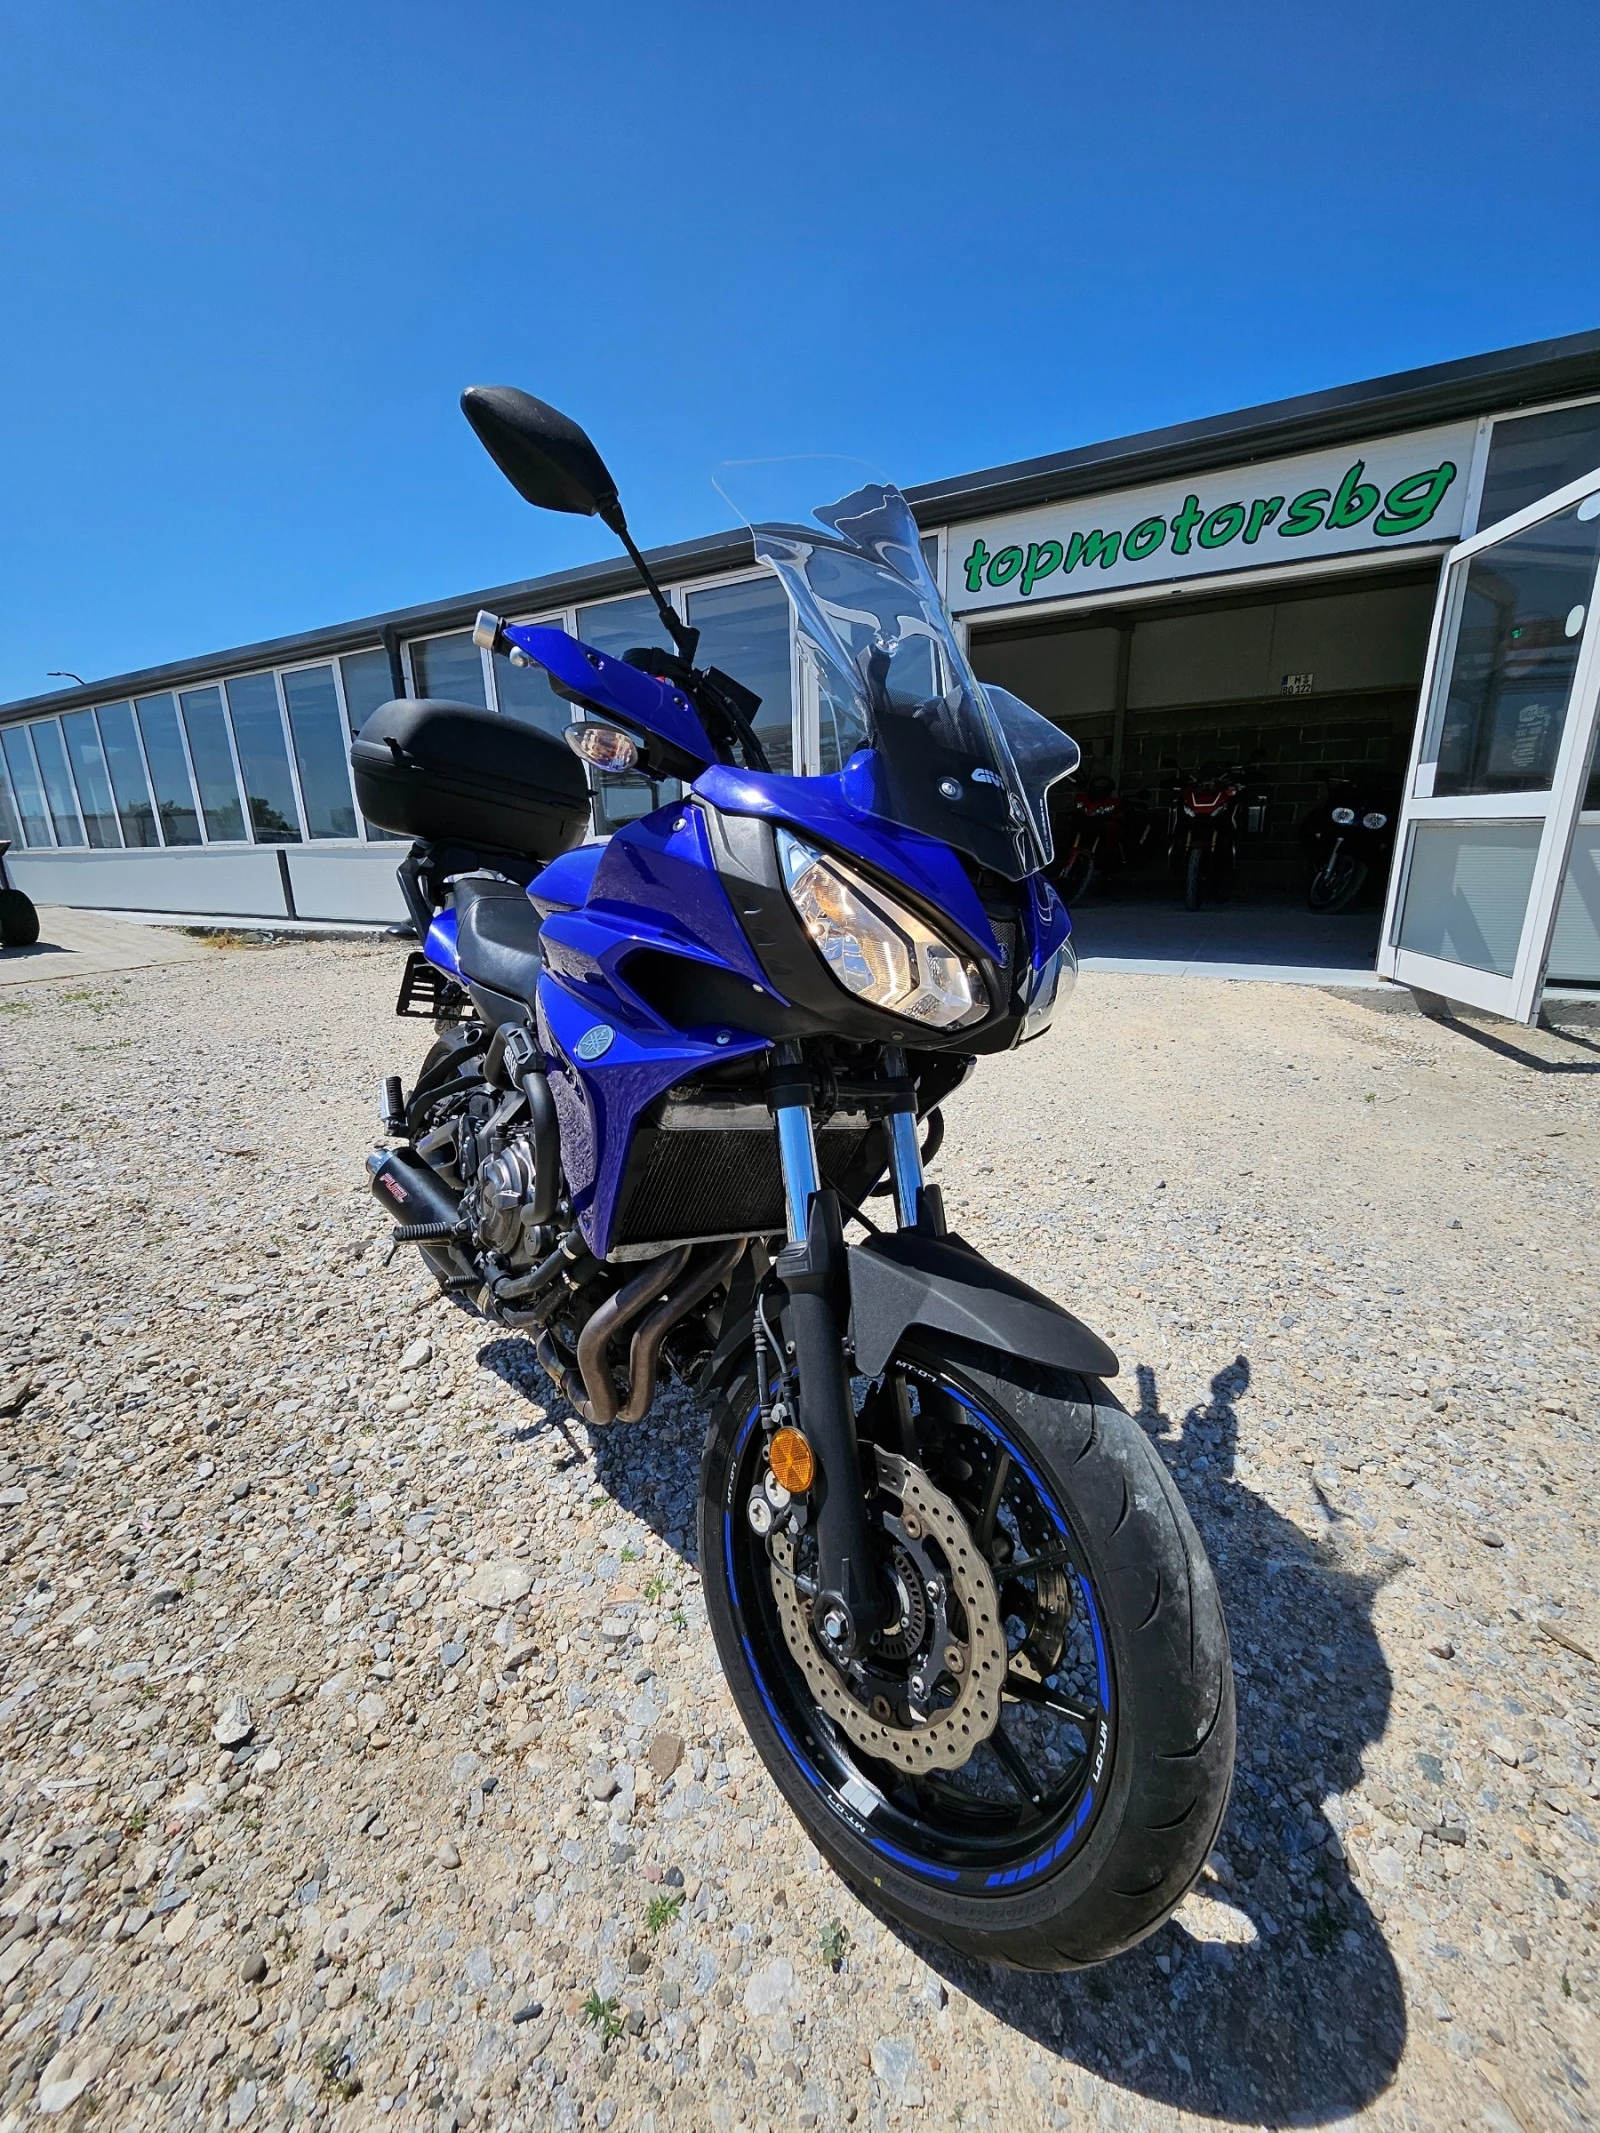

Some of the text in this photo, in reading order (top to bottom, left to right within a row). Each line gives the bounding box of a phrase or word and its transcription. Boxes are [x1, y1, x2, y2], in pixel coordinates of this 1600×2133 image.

[964, 459, 1457, 596] topmotorsbg
[1295, 684, 1311, 694] 122
[895, 1360, 937, 1383] MT-07
[1092, 1720, 1108, 1783] MT-07
[827, 1794, 866, 1833] MT-07
